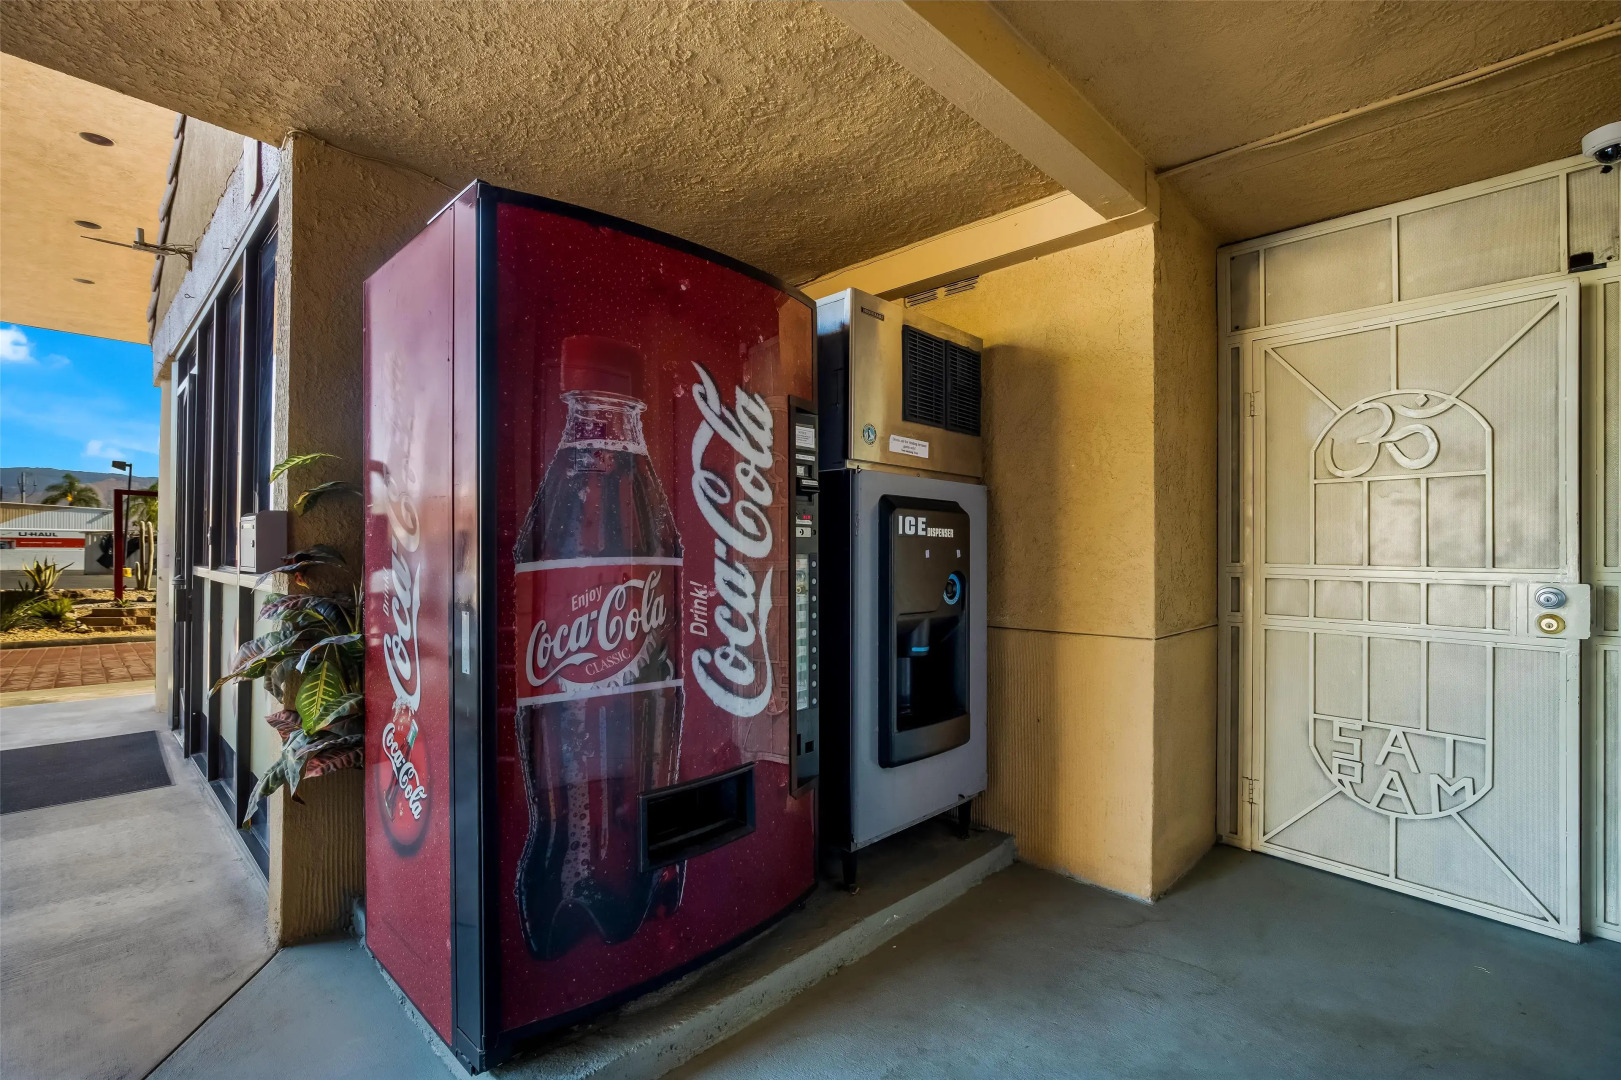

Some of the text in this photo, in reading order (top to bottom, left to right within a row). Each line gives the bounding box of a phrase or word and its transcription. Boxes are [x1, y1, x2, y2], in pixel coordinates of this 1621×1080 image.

[691, 360, 775, 718] Coca-Cola
[898, 515, 954, 538] ICE DISPENSER
[570, 584, 604, 613] Enjoy
[689, 579, 709, 637] Drink!
[525, 569, 668, 687] Coca-Cola
[584, 649, 632, 677] CLASSIC
[381, 721, 428, 820] Coca-Cola
[1332, 720, 1458, 779] SAT
